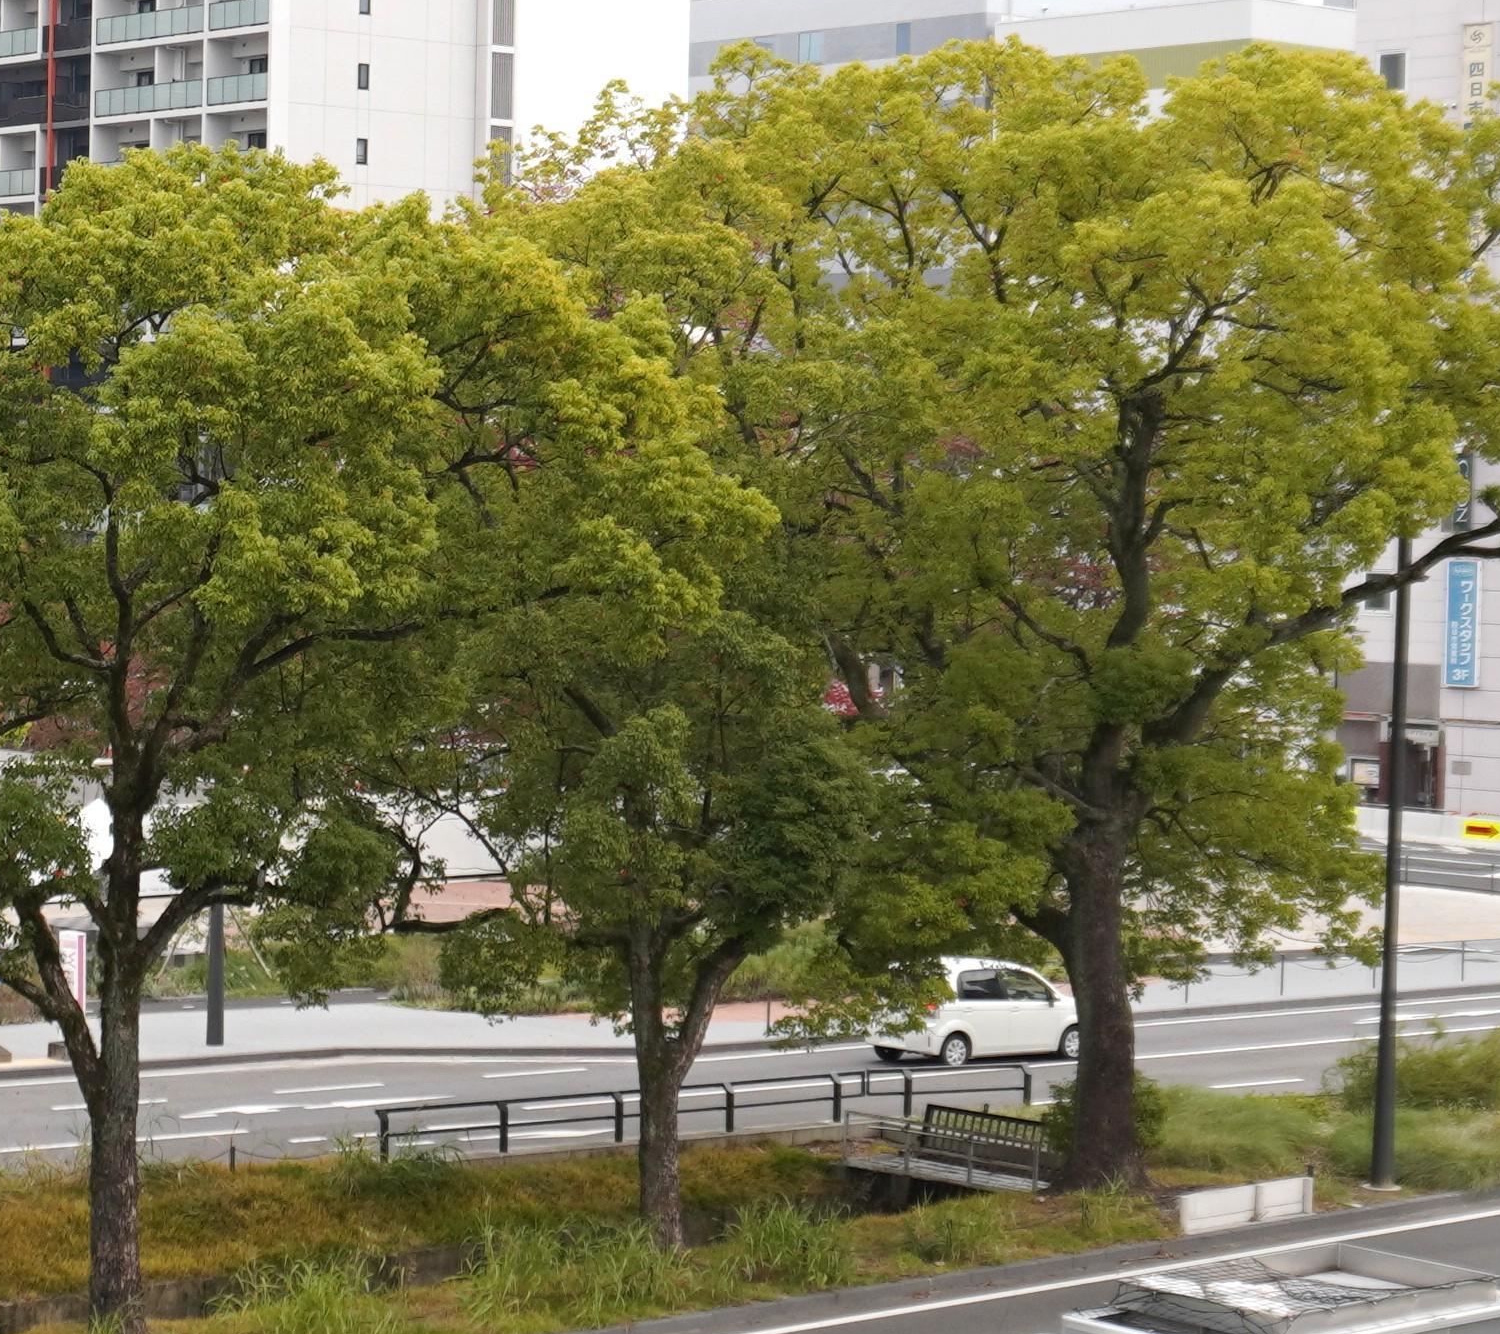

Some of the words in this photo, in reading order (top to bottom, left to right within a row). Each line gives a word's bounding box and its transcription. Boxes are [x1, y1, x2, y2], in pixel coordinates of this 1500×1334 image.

[1460, 580, 1474, 666] ワークスタッフ
[1451, 668, 1470, 681] 3F
